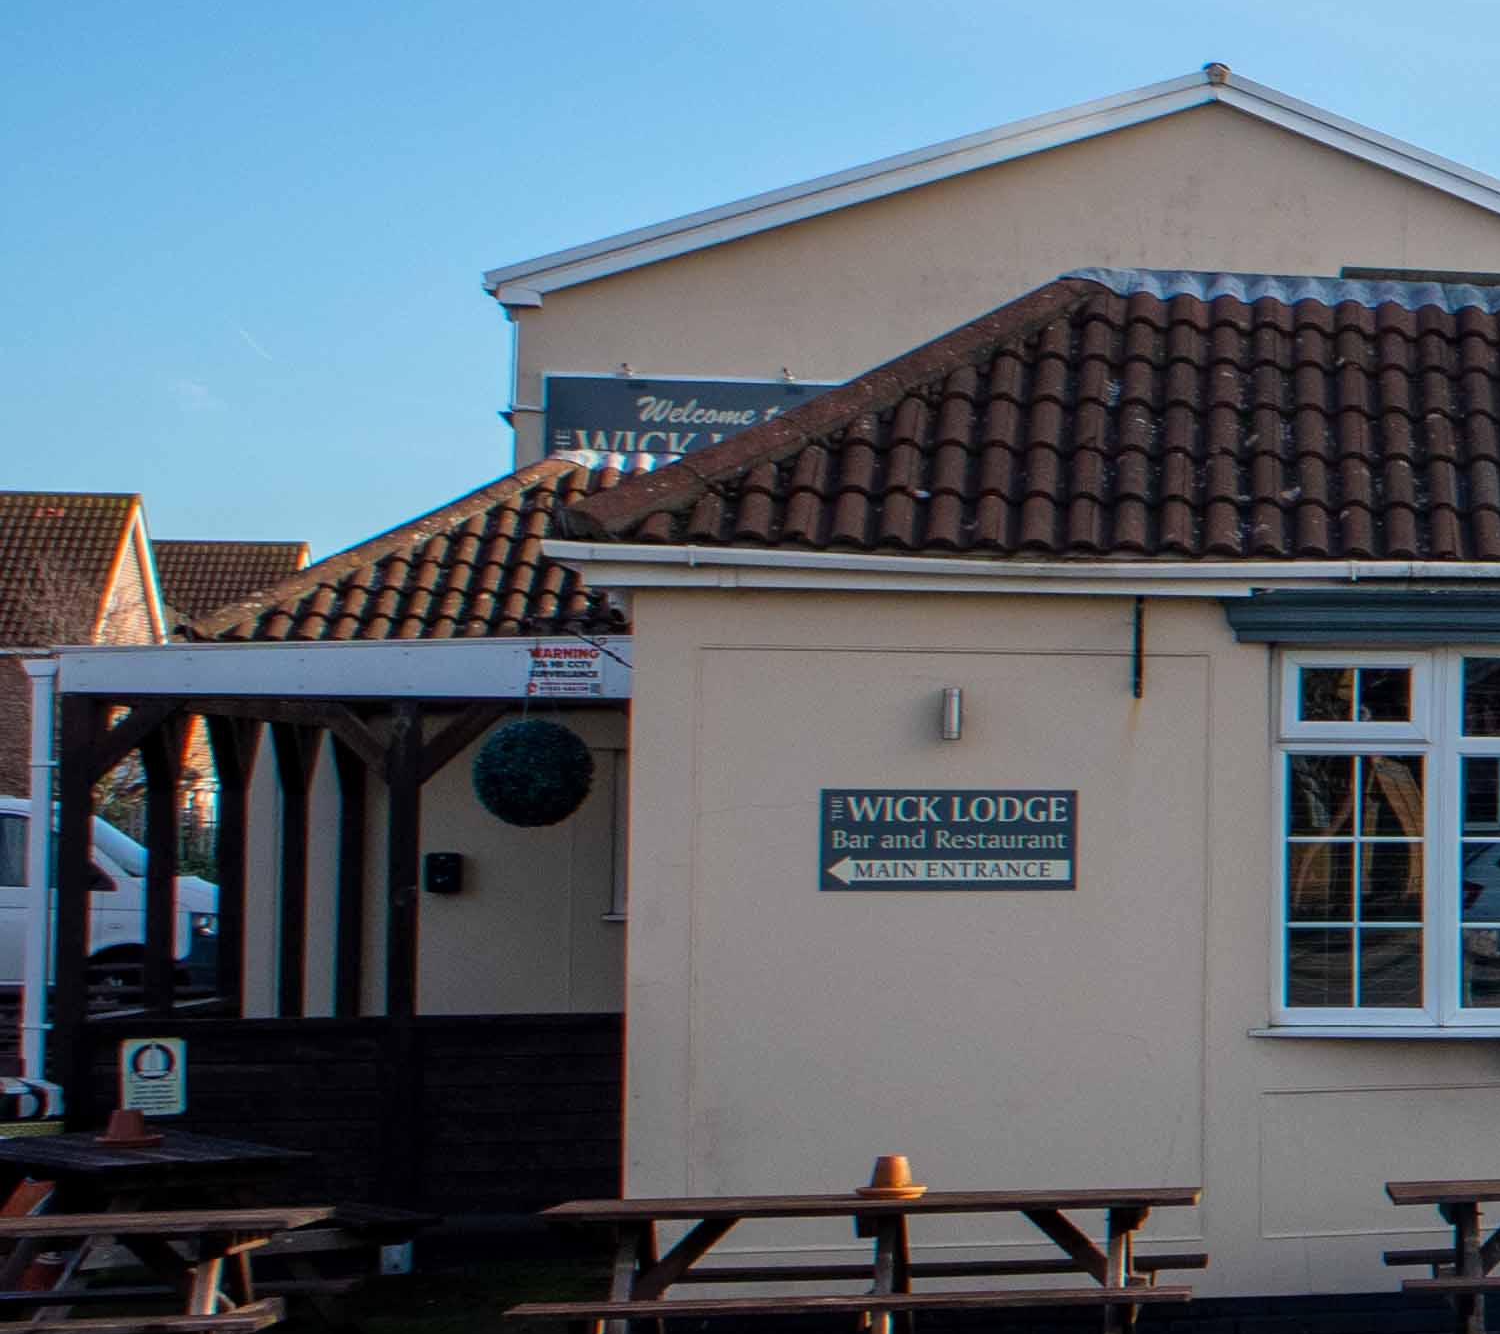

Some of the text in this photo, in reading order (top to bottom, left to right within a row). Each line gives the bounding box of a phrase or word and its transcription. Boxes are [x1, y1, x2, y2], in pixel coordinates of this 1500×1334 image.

[636, 396, 785, 425] Welcome t
[848, 796, 943, 822] WICK
[951, 796, 1068, 822] LODGE
[832, 830, 1067, 849] Bar and Restaurant
[854, 862, 1052, 878] MAIN ENTRANCE
